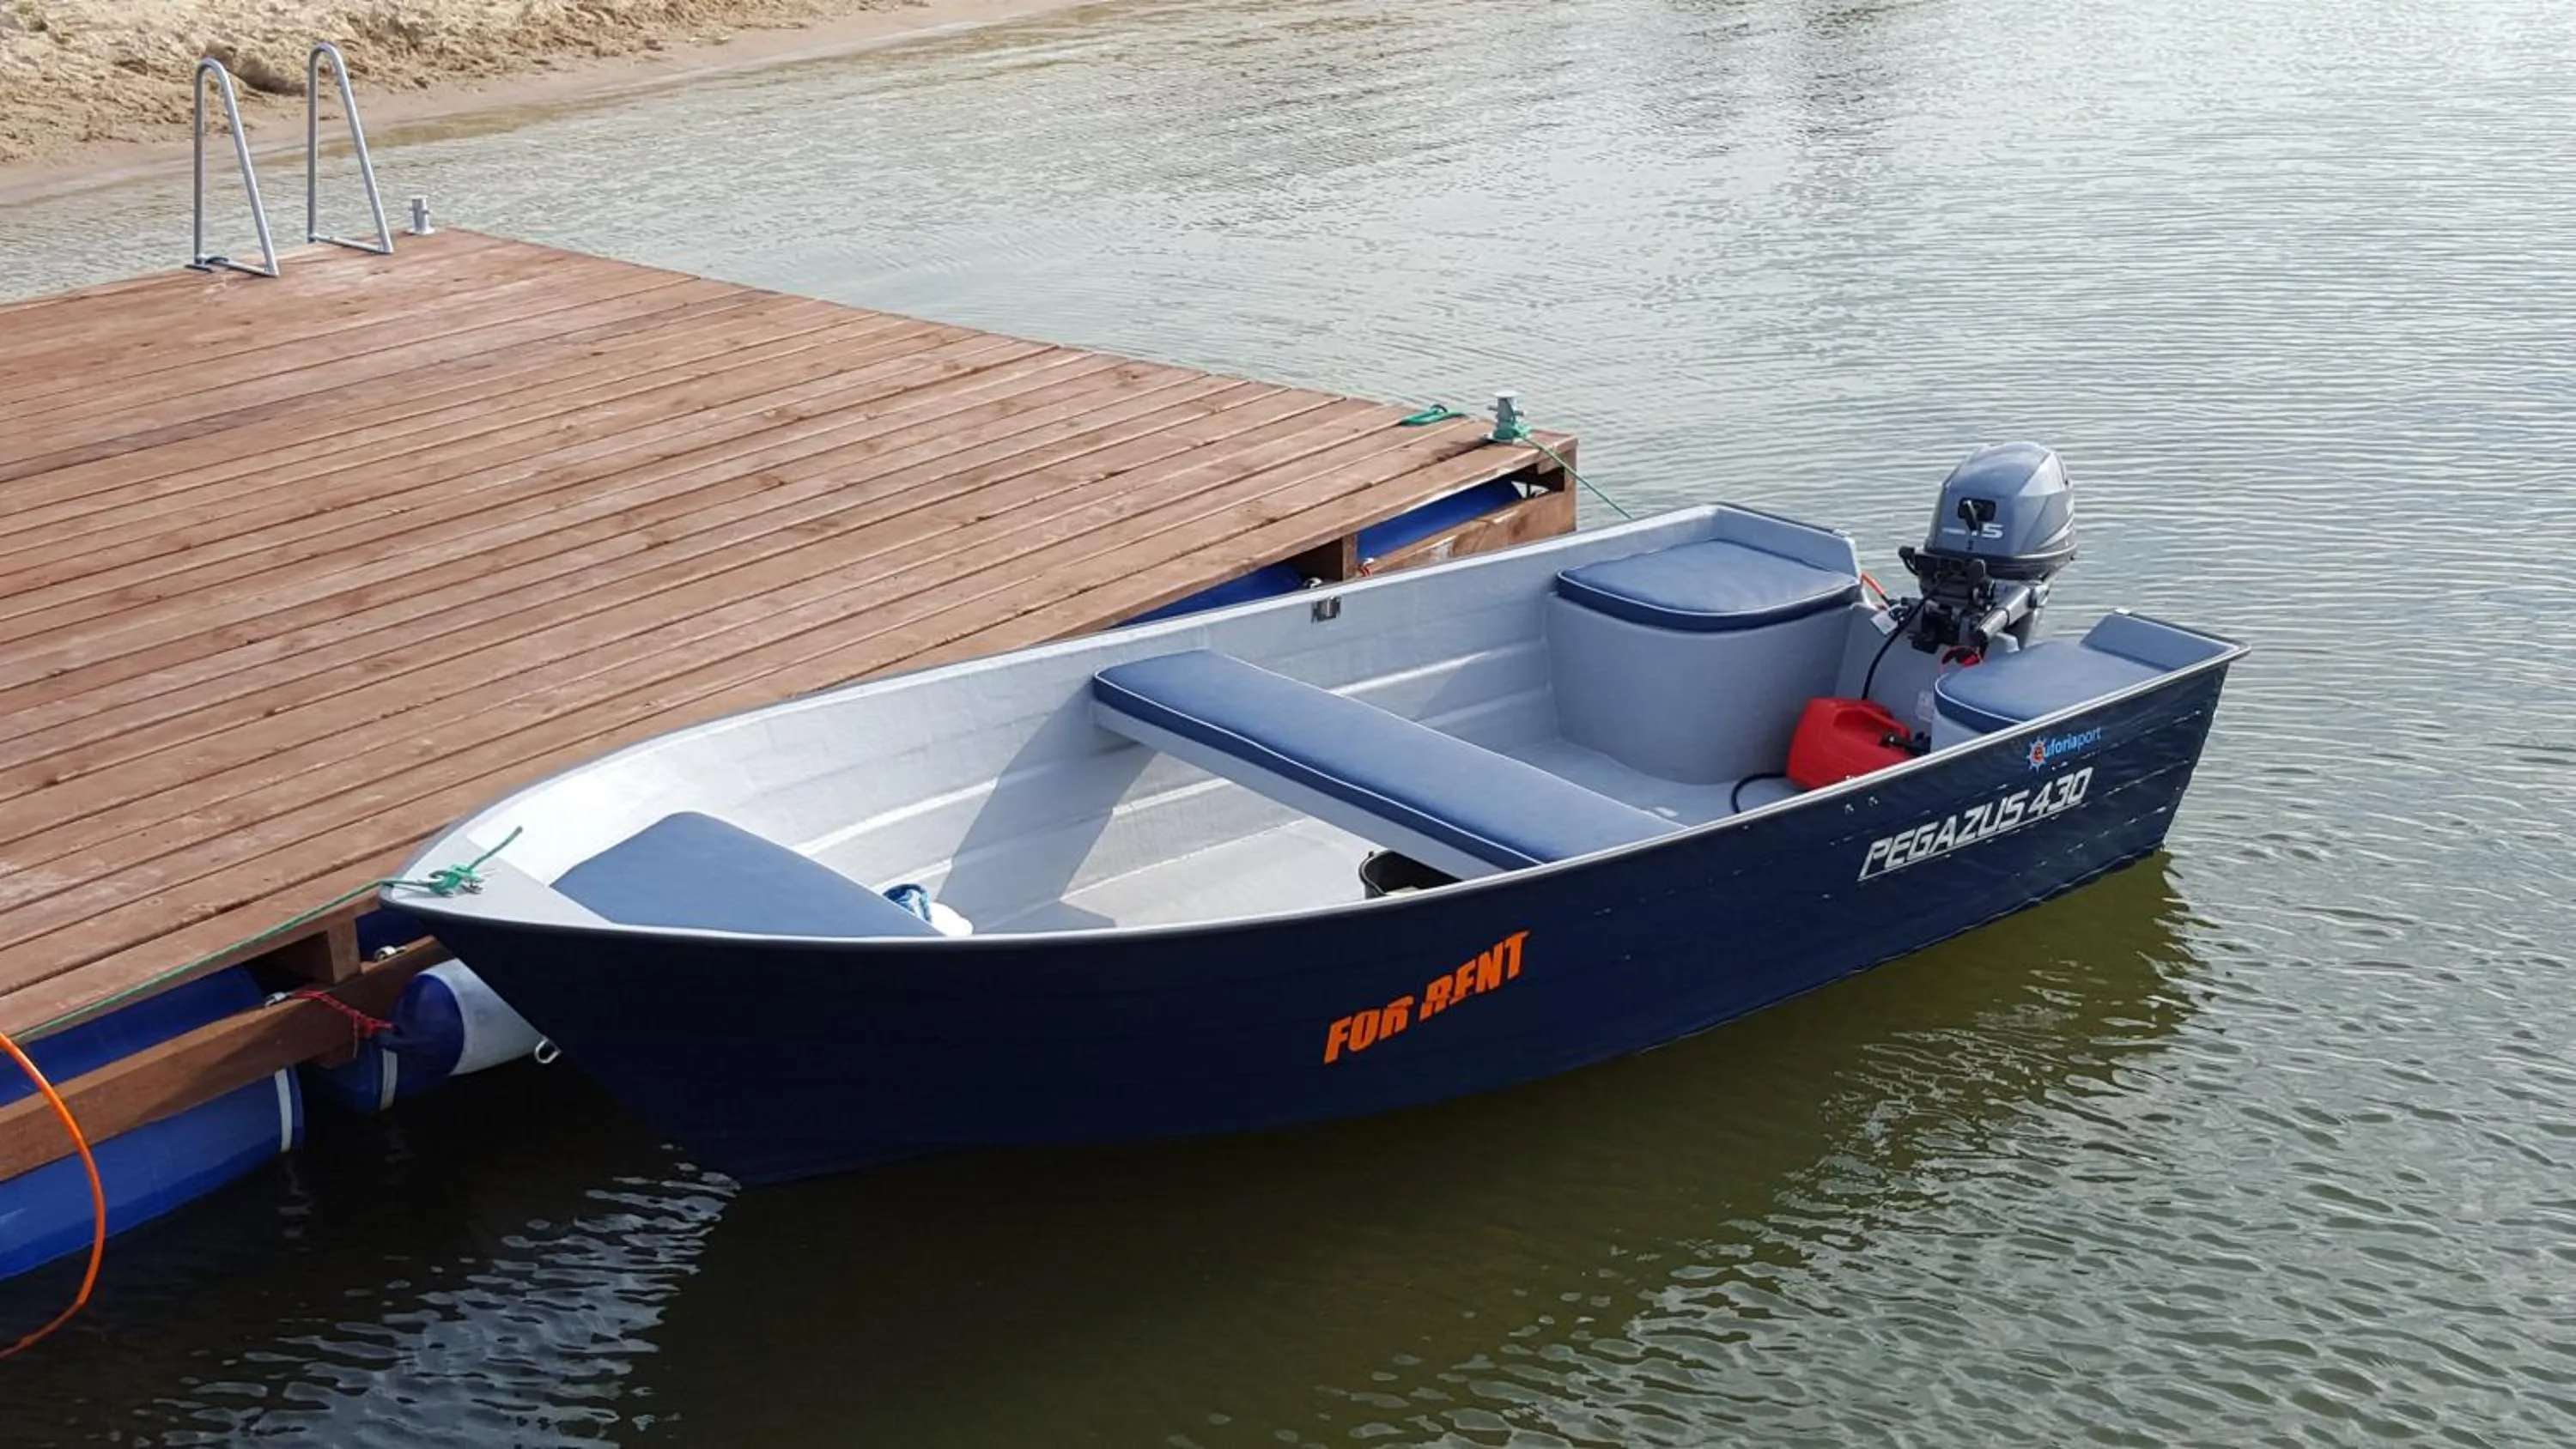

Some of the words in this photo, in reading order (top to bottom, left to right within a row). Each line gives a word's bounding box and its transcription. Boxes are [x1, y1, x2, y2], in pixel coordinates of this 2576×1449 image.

[1858, 790, 2029, 881] PEGAZUS
[2027, 767, 2093, 815] 430
[1324, 995, 1414, 1064] FOR
[1419, 930, 1529, 1021] RENT
